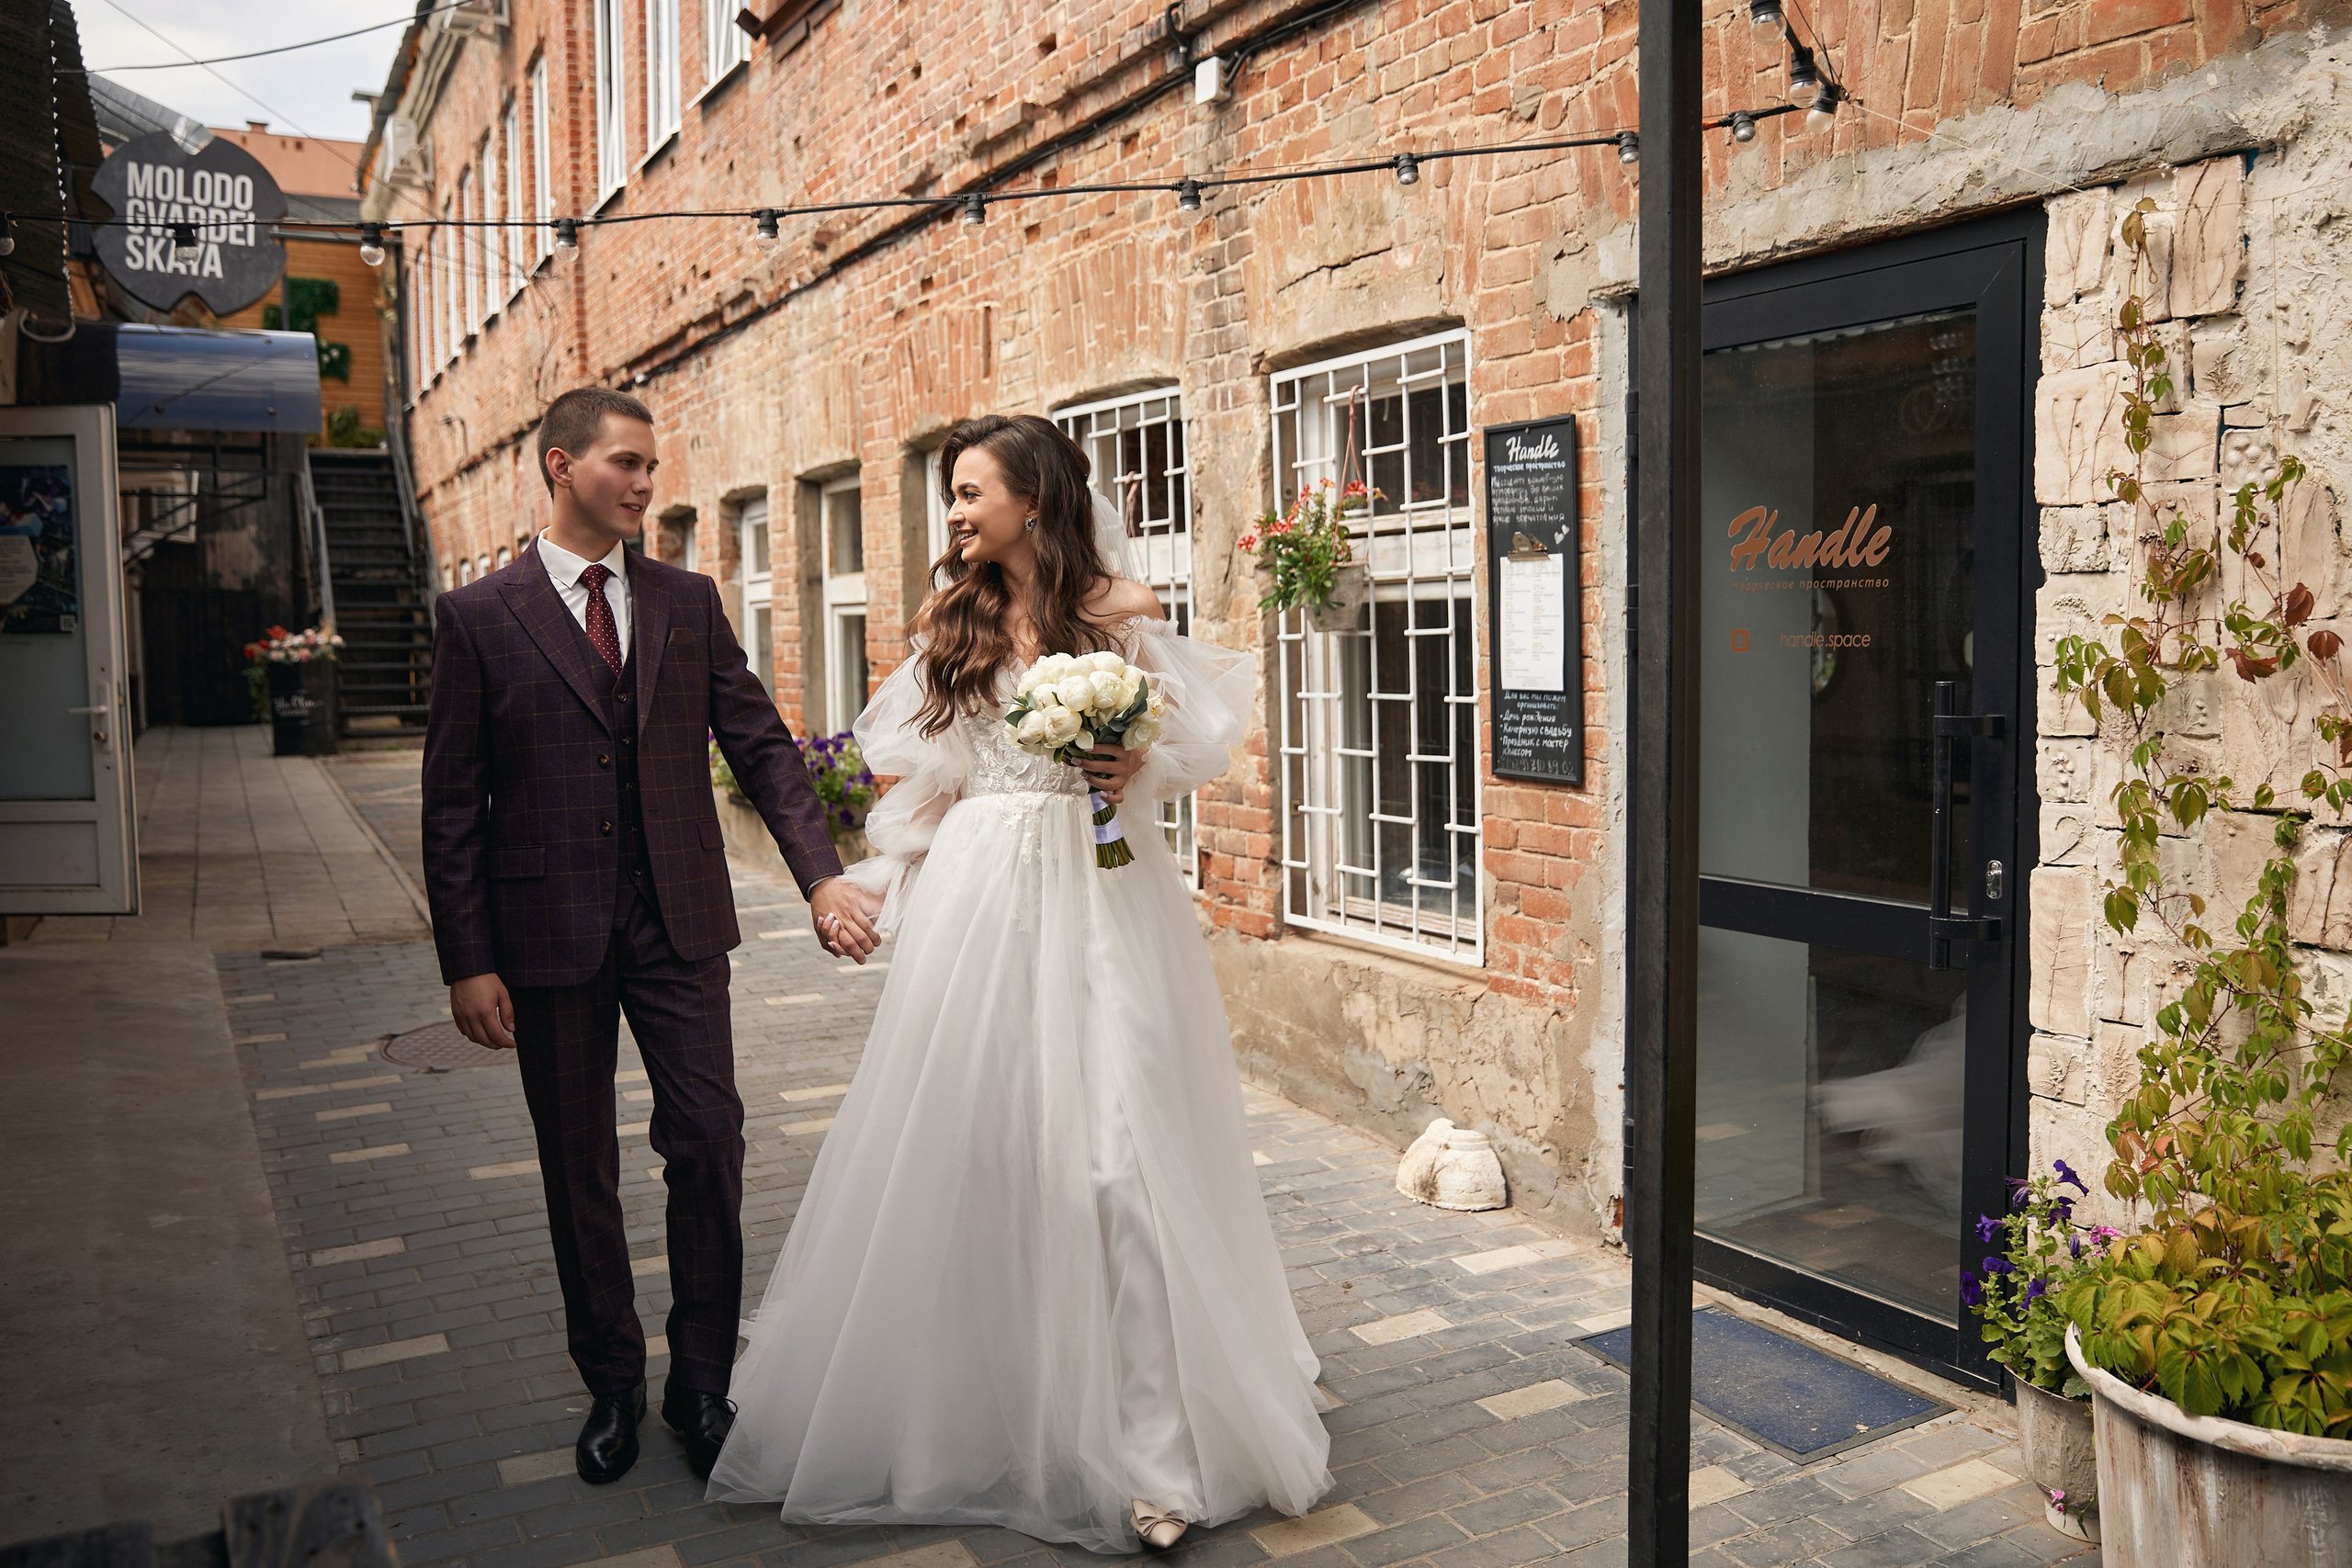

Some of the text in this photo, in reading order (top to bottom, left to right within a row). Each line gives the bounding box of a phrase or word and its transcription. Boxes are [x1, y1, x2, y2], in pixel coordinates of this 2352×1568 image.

[127, 161, 254, 211] MOLODO
[1506, 434, 1559, 462] Handle
[1728, 503, 1892, 571] Handle
[1730, 579, 1890, 593] творческое пространство
[1780, 631, 1871, 650] handle.space
[1543, 739, 1569, 753] мастер
